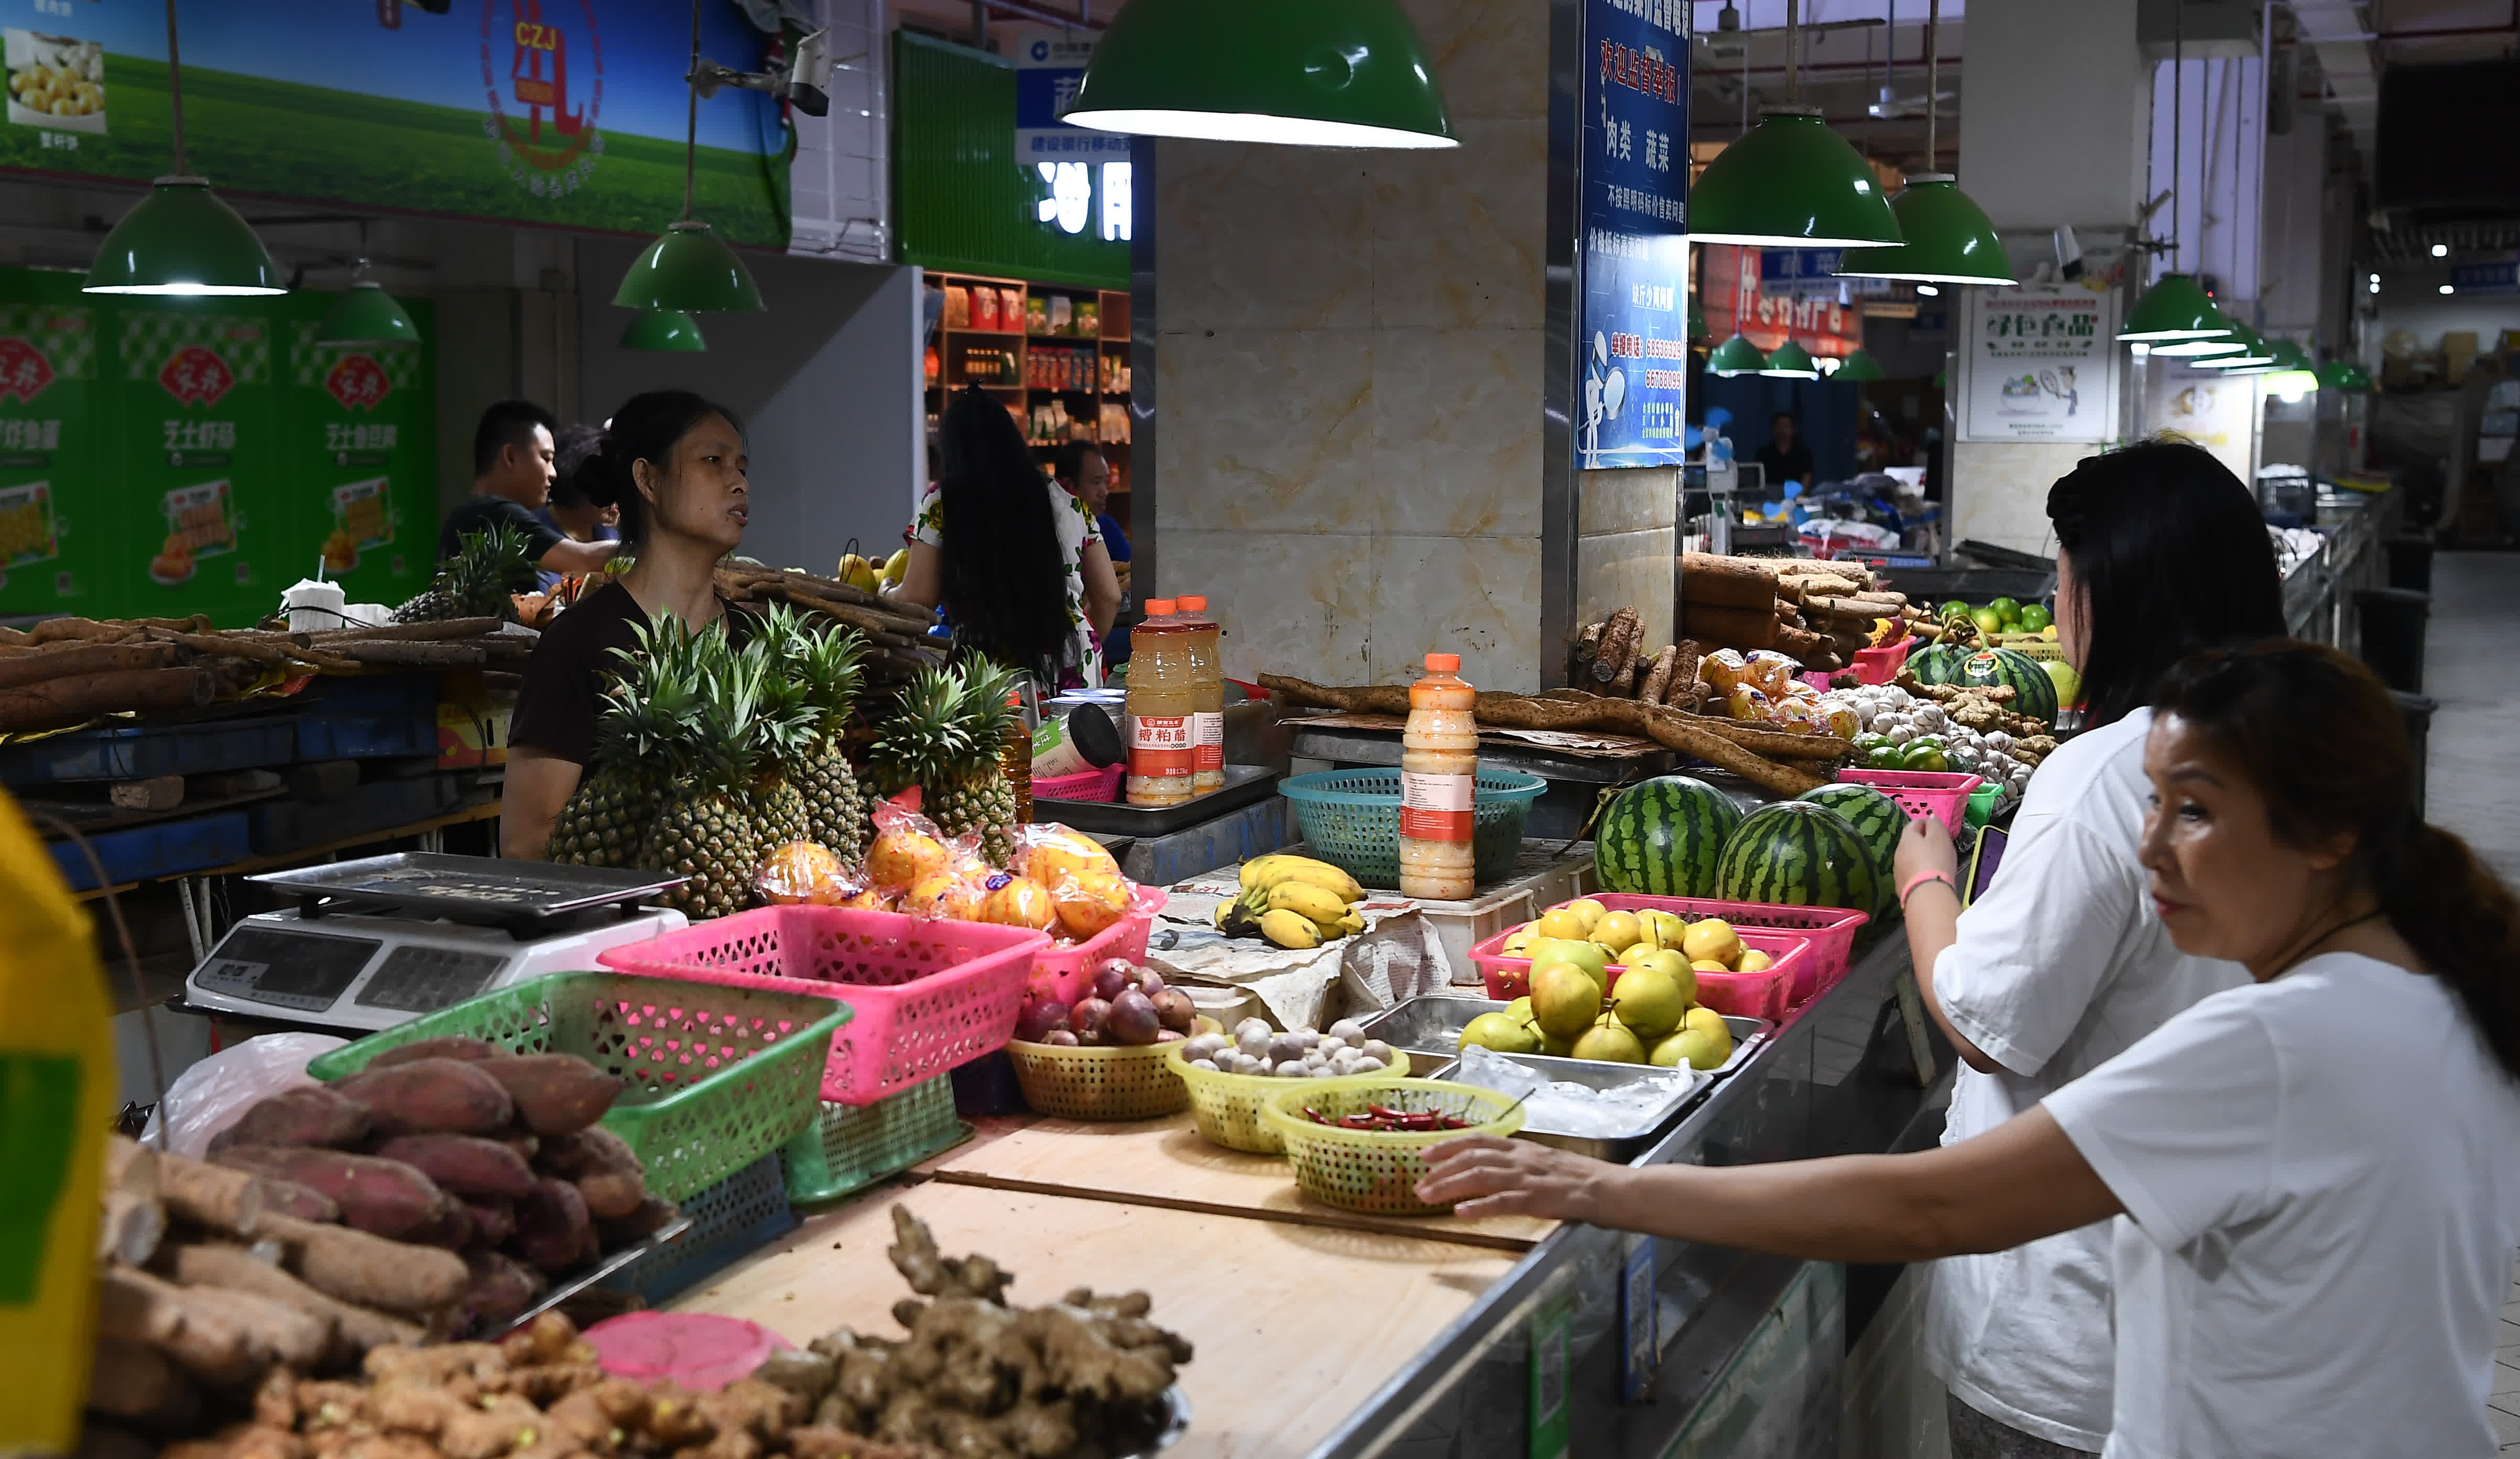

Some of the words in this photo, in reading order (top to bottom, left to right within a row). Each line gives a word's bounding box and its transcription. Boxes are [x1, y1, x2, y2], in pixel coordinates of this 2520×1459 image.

[516, 21, 556, 51] CZJ
[1606, 115, 1632, 162] 肉类
[1645, 129, 1670, 173] 蔬菜
[1608, 184, 1685, 224] 不按照明码标价售卖问题
[1645, 370, 1681, 390] 66788099
[1138, 728, 1186, 743] 糟粕醋
